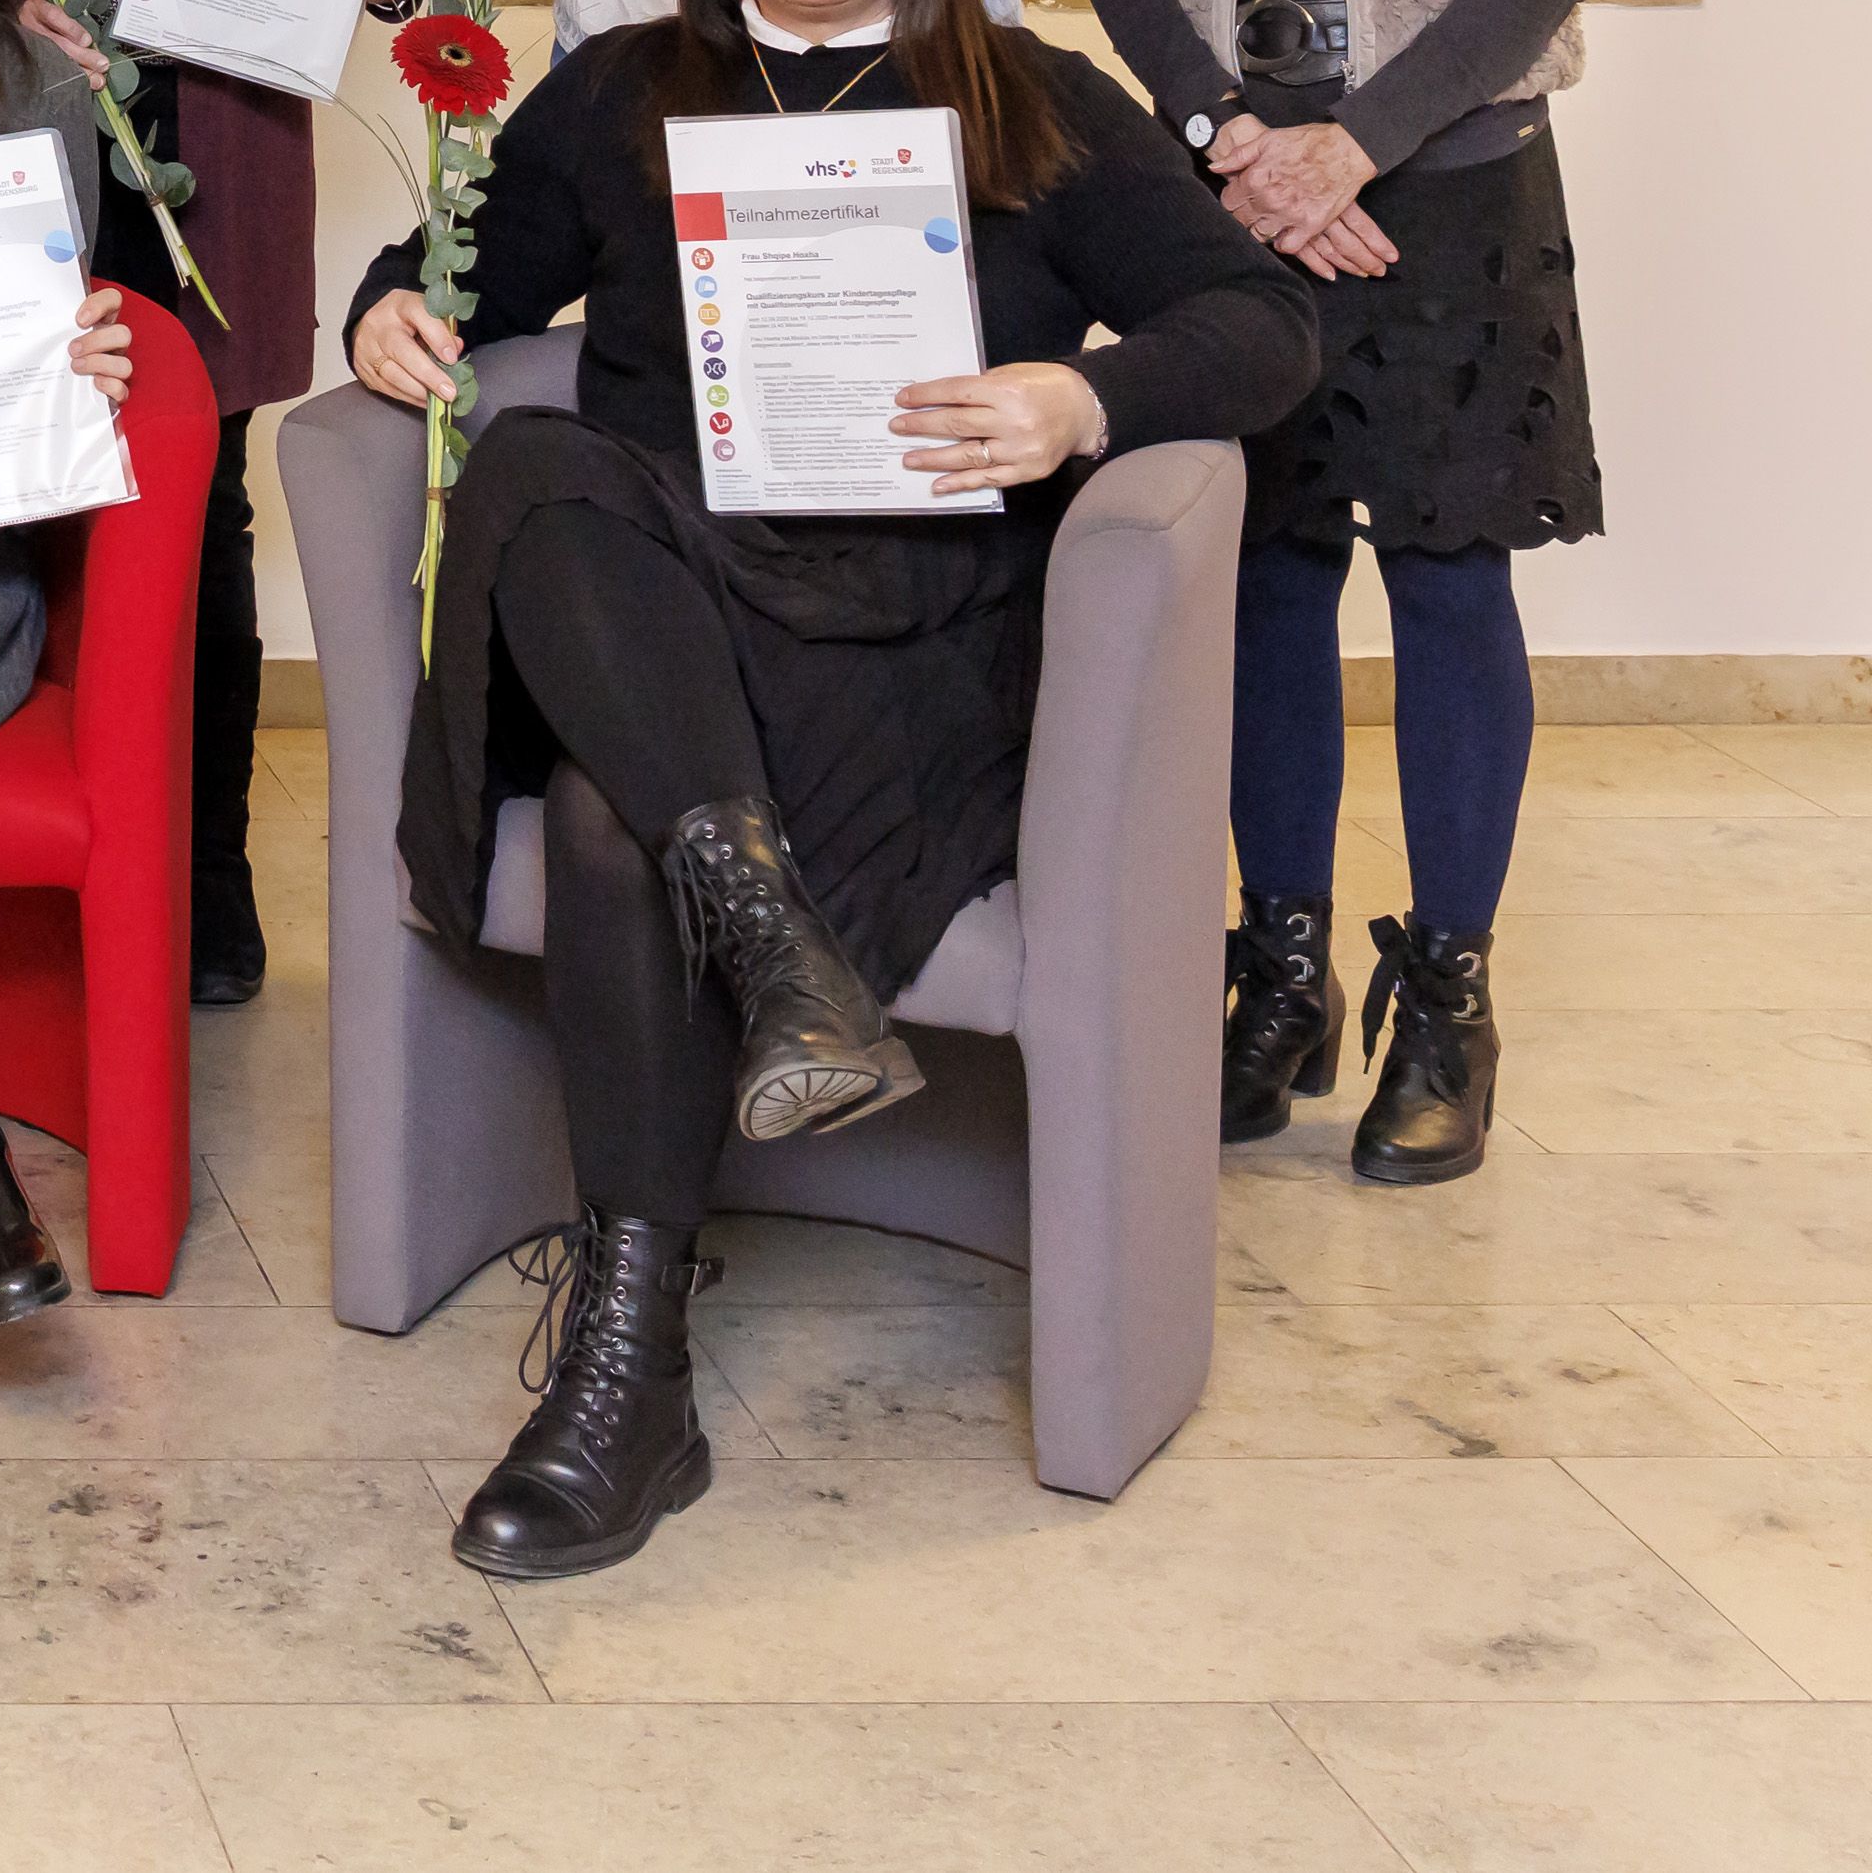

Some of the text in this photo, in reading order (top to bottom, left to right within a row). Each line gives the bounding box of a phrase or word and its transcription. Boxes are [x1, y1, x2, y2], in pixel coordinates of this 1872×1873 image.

[871, 157, 894, 166] STADT
[805, 160, 838, 177] vhs
[871, 166, 924, 175] REGENSBURG
[727, 205, 880, 224] Teilnahmezertifikat
